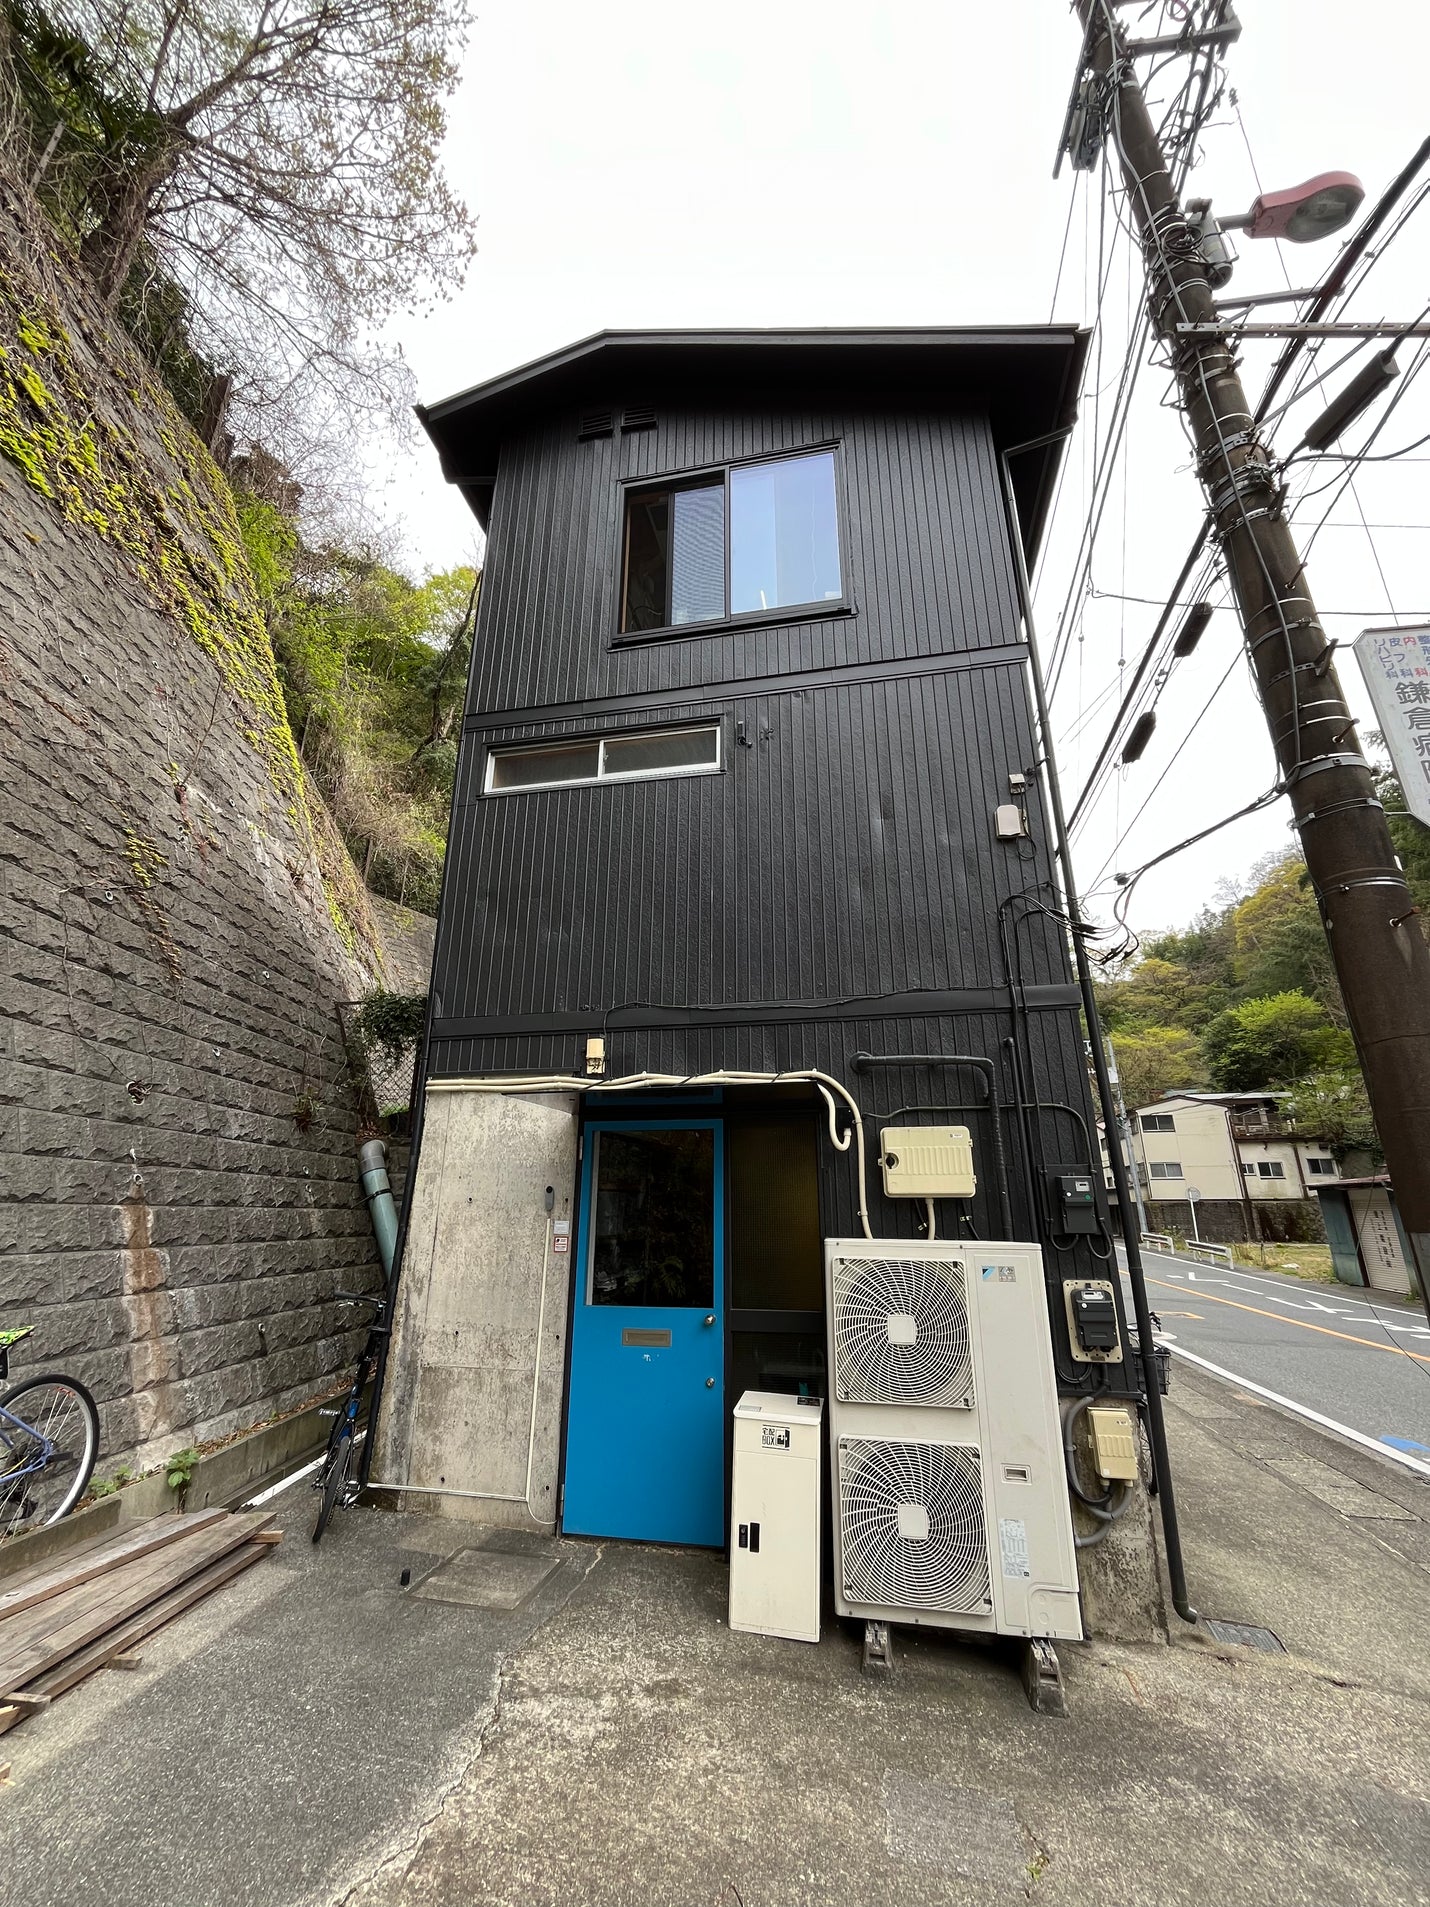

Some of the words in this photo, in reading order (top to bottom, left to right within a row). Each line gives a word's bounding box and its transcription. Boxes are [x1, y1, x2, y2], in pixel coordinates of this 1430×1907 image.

[1374, 639, 1399, 679] リハビリ科
[1389, 638, 1413, 678] 皮フ科
[1403, 636, 1428, 677] 内科
[762, 1435, 775, 1446] BOX
